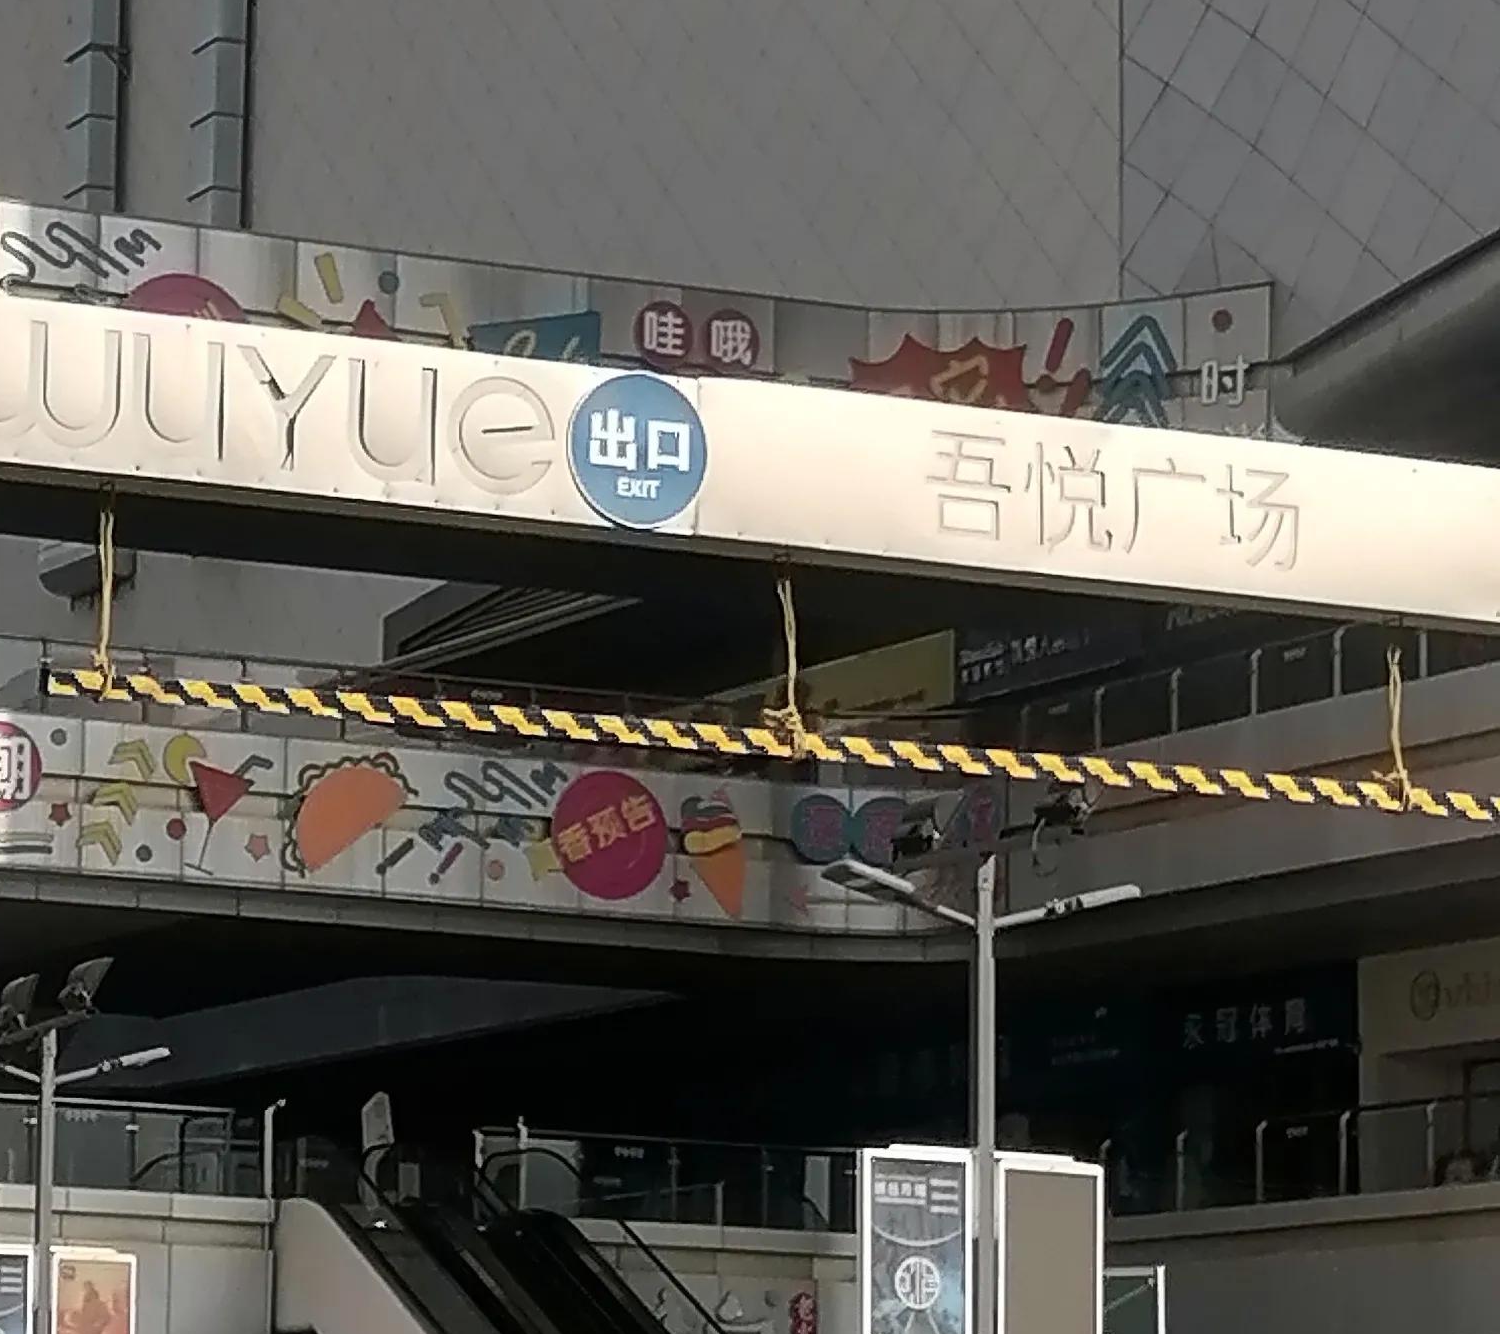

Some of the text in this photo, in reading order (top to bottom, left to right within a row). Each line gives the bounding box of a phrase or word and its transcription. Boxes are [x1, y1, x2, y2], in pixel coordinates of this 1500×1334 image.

[588, 407, 691, 475] 出口
[616, 476, 661, 501] EXIT
[925, 429, 1303, 570] 吾悦广场
